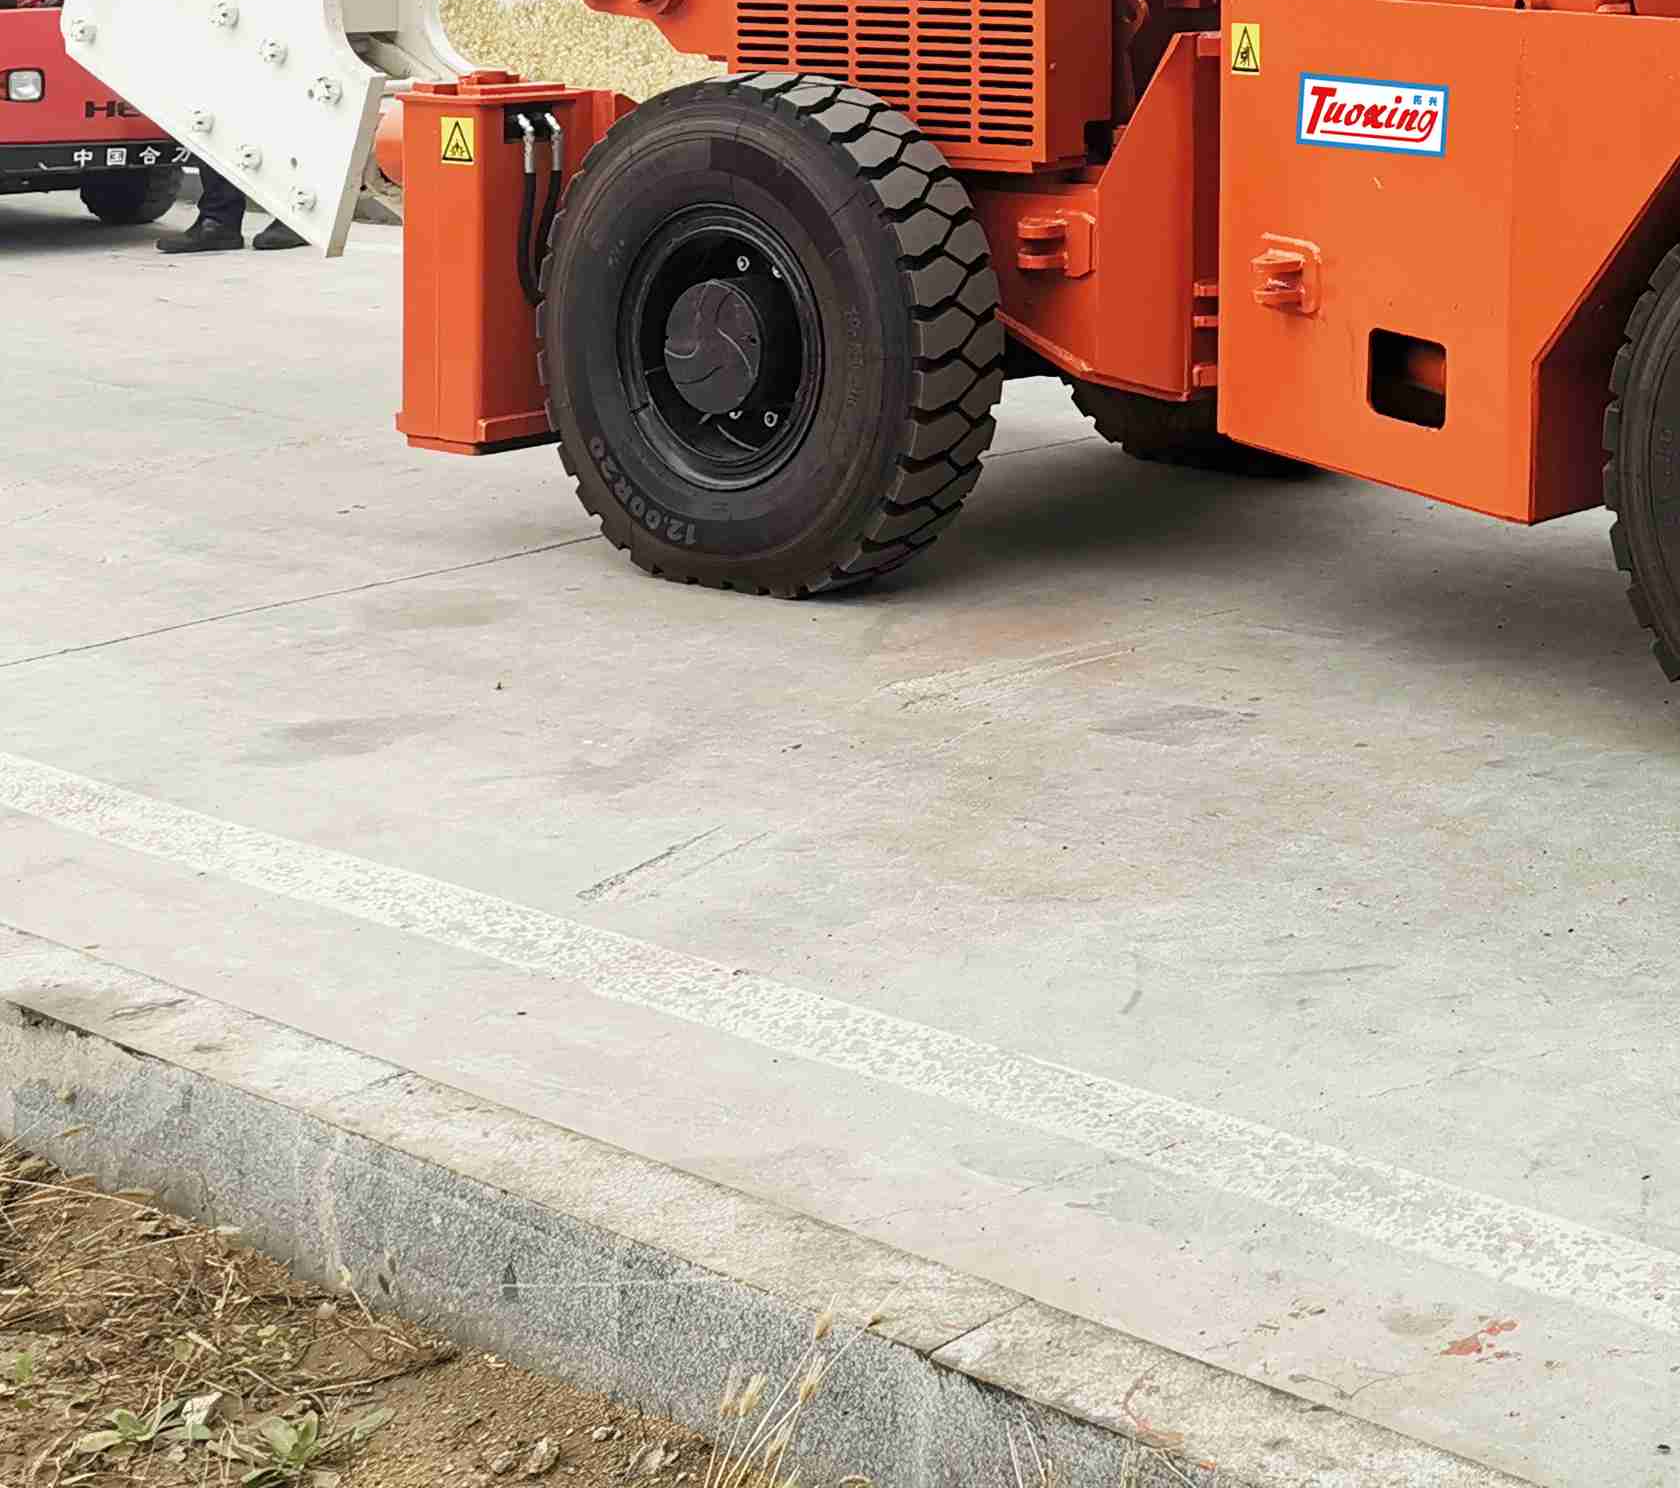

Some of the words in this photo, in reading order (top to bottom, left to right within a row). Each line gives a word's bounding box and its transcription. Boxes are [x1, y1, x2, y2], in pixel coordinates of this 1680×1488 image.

[1306, 86, 1439, 143] Tuoxing
[73, 146, 191, 168] 中国合力
